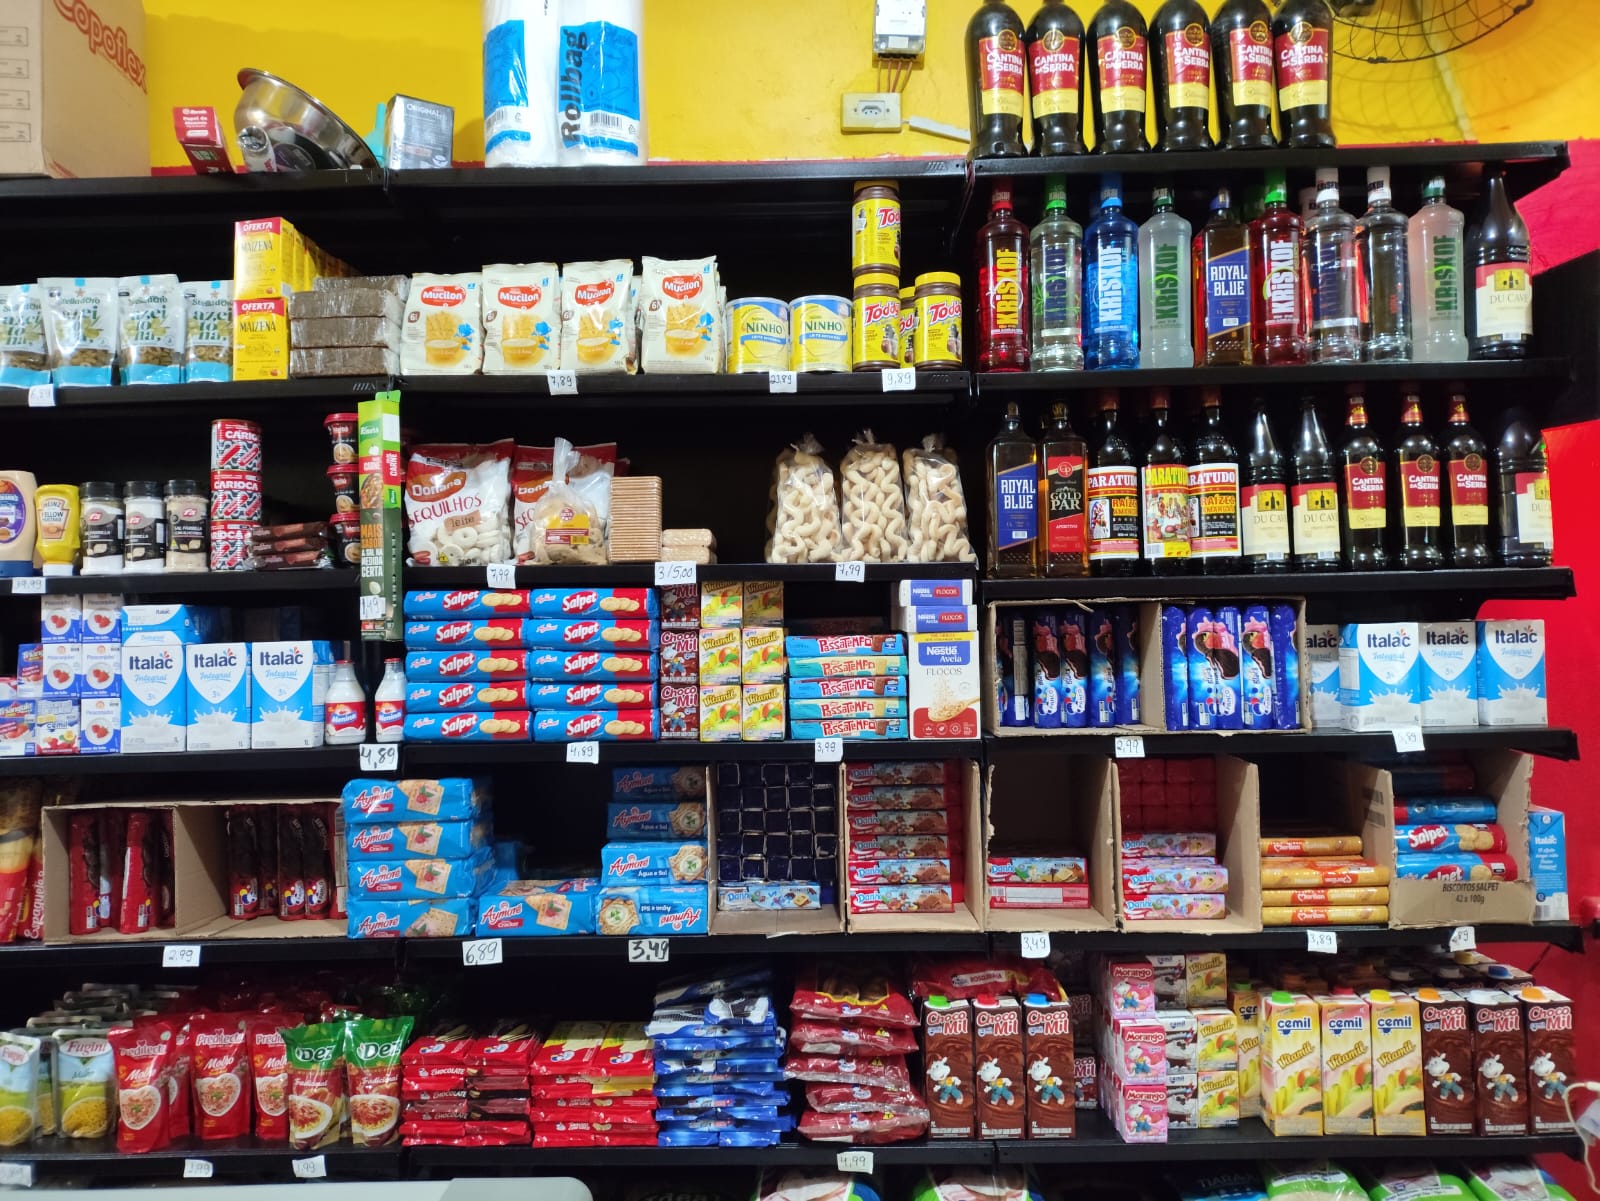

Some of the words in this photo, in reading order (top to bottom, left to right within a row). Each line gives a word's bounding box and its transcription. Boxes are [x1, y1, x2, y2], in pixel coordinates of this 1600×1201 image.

[1034, 55, 1074, 65] CANTINA
[1105, 51, 1143, 62] CANTINA
[1043, 63, 1075, 73] SERRA
[1114, 60, 1143, 71] SERRA
[560, 29, 587, 143] Rollbag
[243, 222, 273, 232] OFERTA
[1210, 265, 1248, 280] ROYAL
[577, 287, 612, 300] Mucilon
[664, 280, 700, 293] Mucilon
[1213, 281, 1245, 297] BLUE
[422, 291, 464, 301] Mucilon
[499, 292, 540, 302] Mucilon
[242, 302, 276, 312] OFERTA
[240, 322, 276, 333] MAIZENA
[746, 322, 783, 335] NINHO
[805, 320, 843, 332] NINHO
[550, 375, 572, 388] 7,89
[887, 371, 911, 385] 9,89
[1352, 476, 1384, 486] CANTINA
[1408, 474, 1440, 484] CANTINA
[1456, 473, 1487, 482] CANTINA
[214, 480, 259, 491] CARIOCA
[1001, 480, 1036, 494] ROYAL
[1004, 495, 1034, 509] BLUE
[1051, 492, 1081, 501] GOLD
[409, 494, 482, 527] SEQUILHOS
[1052, 499, 1081, 511] PAR
[490, 568, 511, 581] 7,99
[839, 565, 861, 577] 7,99
[446, 591, 479, 608] Salpet
[563, 592, 597, 612] Salpet
[436, 623, 472, 641] Salpet
[565, 622, 600, 640] Salpet
[1426, 631, 1469, 645] Italac
[1495, 629, 1537, 644] Italac
[661, 632, 697, 645] Choco
[676, 639, 697, 651] Mil
[703, 635, 736, 650] Vitamil
[745, 634, 779, 649] Vitamil
[1367, 633, 1411, 648] Italac
[927, 645, 957, 655] Nestlé
[129, 655, 173, 671] Italac
[194, 653, 237, 668] Italac
[260, 651, 303, 666] Italac
[440, 655, 475, 673] Salpet
[565, 653, 600, 672] Salpet
[940, 655, 962, 663] Aveia
[926, 667, 963, 676] FLOCOS
[439, 685, 474, 704] Salpet
[567, 685, 602, 703] Salpet
[661, 686, 697, 700] Choco
[703, 691, 736, 706] Vitamil
[745, 690, 779, 706] Vitamil
[676, 695, 698, 707] Mil
[442, 716, 477, 735] Salpet
[567, 716, 602, 735] Salpet
[570, 745, 593, 757] 4,89
[361, 749, 396, 769] 4,89
[612, 810, 652, 828] Aymoré
[353, 828, 394, 848] Aymoré
[1408, 824, 1448, 847] Salpet
[608, 857, 650, 876] Aymoré
[359, 866, 401, 887] Aymoré
[1443, 882, 1475, 892] BISCOITOS
[1475, 882, 1499, 891] SALPET
[480, 903, 522, 925] Aymoré
[660, 908, 702, 927] Aymoré
[358, 914, 400, 934] Aymoré
[1024, 936, 1047, 951] 3,49
[1310, 935, 1333, 945] 3,89
[465, 942, 498, 966] 6,89
[631, 940, 669, 961] 3,49
[1190, 957, 1223, 973] Vitamil
[1114, 968, 1152, 979] Morango
[927, 1011, 967, 1025] Choco
[977, 1011, 1017, 1026] Choco
[1027, 1011, 1068, 1025] Choco
[1424, 1006, 1464, 1021] Choco
[1477, 1008, 1519, 1022] Choco
[1529, 1006, 1570, 1021] Choco
[943, 1021, 968, 1035] Mil
[993, 1021, 1019, 1035] Mil
[1044, 1021, 1069, 1035] Mil
[1277, 1017, 1311, 1029] cemil
[1328, 1016, 1363, 1028] cemil
[1377, 1015, 1412, 1027] cemil
[1440, 1015, 1467, 1031] Mil
[1494, 1017, 1520, 1032] Mil
[1545, 1015, 1572, 1031] Mil
[1201, 1021, 1234, 1037] Vitamil
[1126, 1032, 1164, 1043] Morango
[67, 1040, 106, 1054] Fugini
[1376, 1040, 1416, 1067] Vitamil
[1277, 1041, 1316, 1069] Vitamil
[1326, 1041, 1368, 1070] Vitamil
[205, 1056, 234, 1069] Molho
[431, 1067, 465, 1076] CHOCOLATE
[1202, 1076, 1235, 1092] Vitamil
[433, 1090, 467, 1099] CHOCOLATE
[1127, 1091, 1166, 1102] Morango
